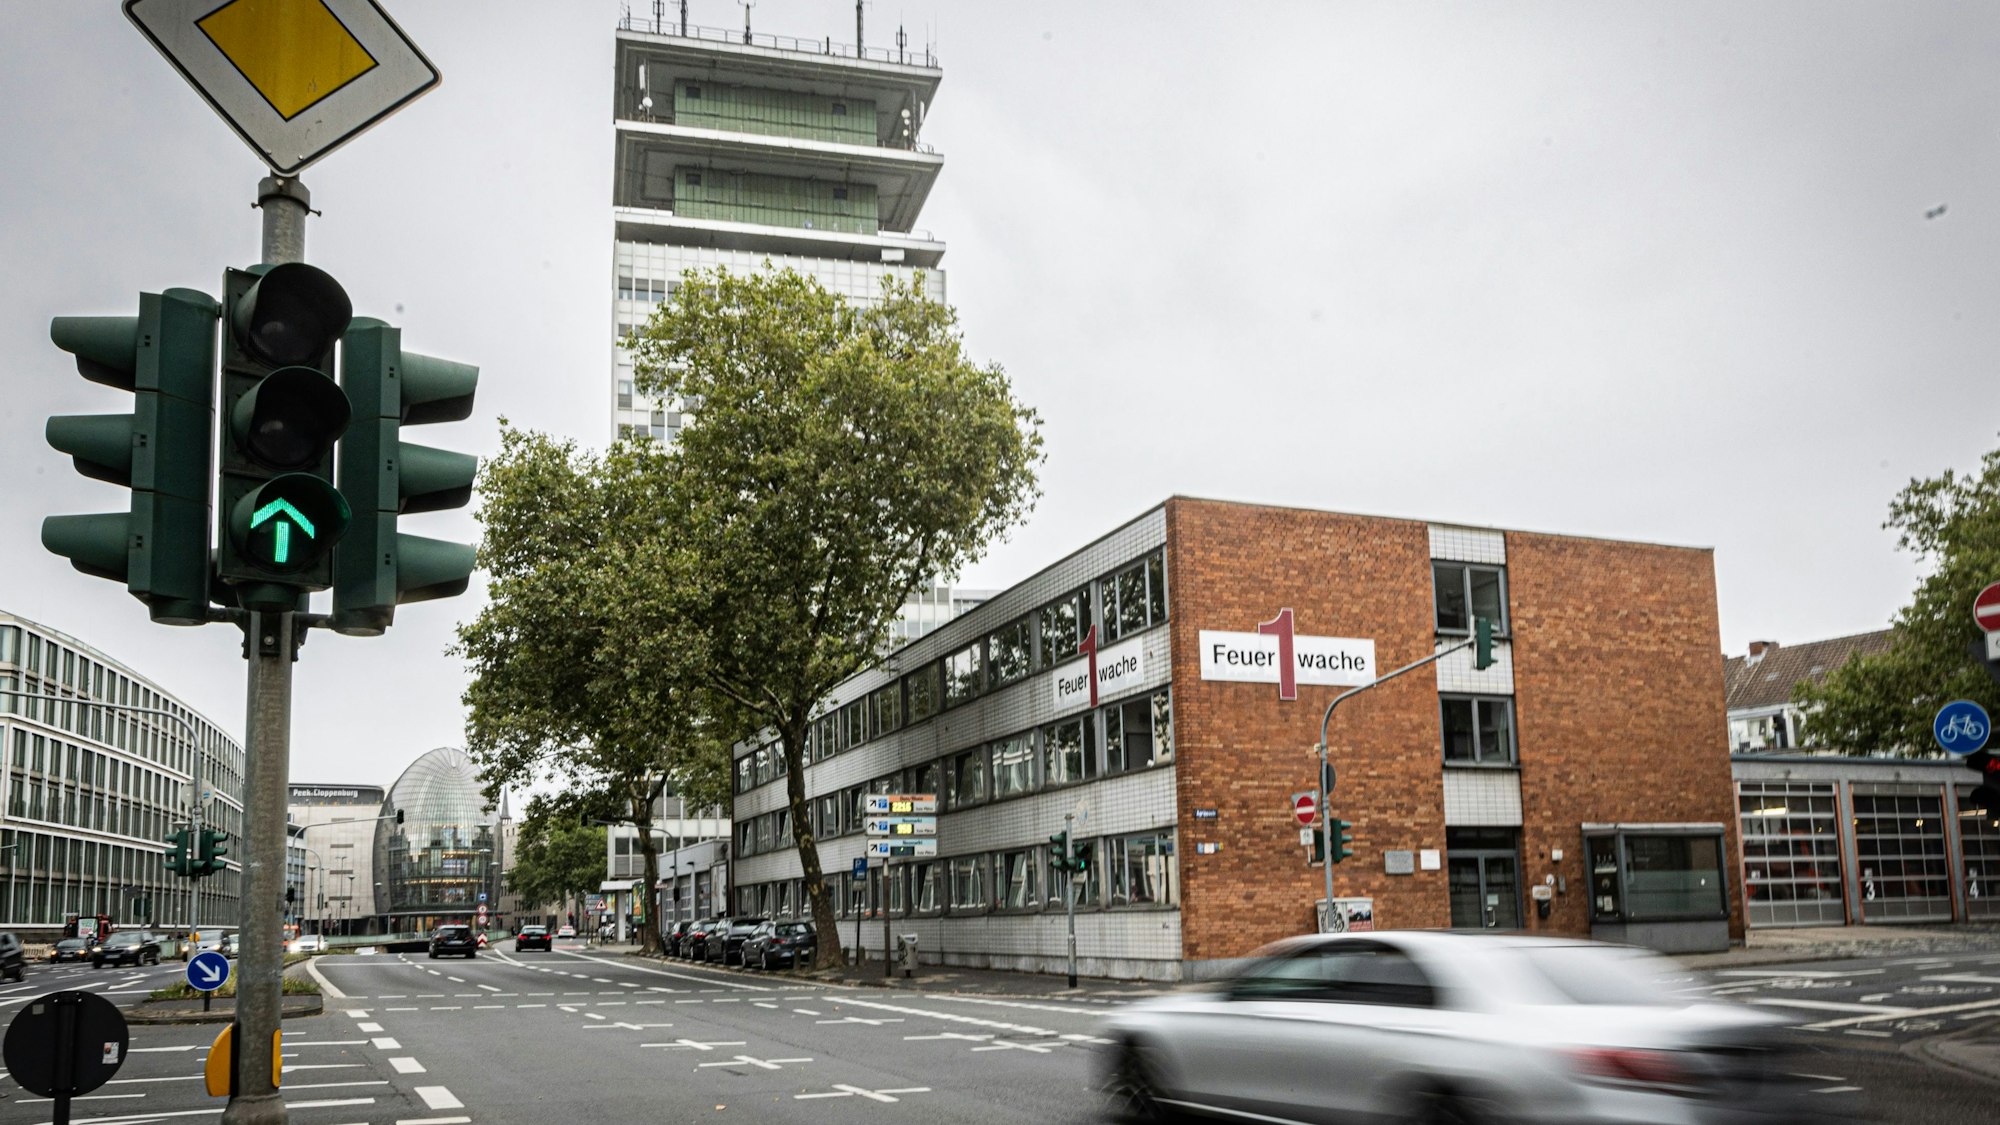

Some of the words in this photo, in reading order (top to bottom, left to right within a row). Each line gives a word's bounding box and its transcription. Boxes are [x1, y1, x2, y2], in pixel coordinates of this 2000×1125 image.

[1058, 673, 1088, 698] Feuer
[1077, 624, 1099, 709] 1
[1099, 655, 1137, 682] wache
[1213, 643, 1275, 667] Feuer
[1258, 607, 1297, 701] 1
[1298, 651, 1365, 671] wache
[1865, 880, 1875, 901] 3
[1969, 880, 1979, 899] 4
